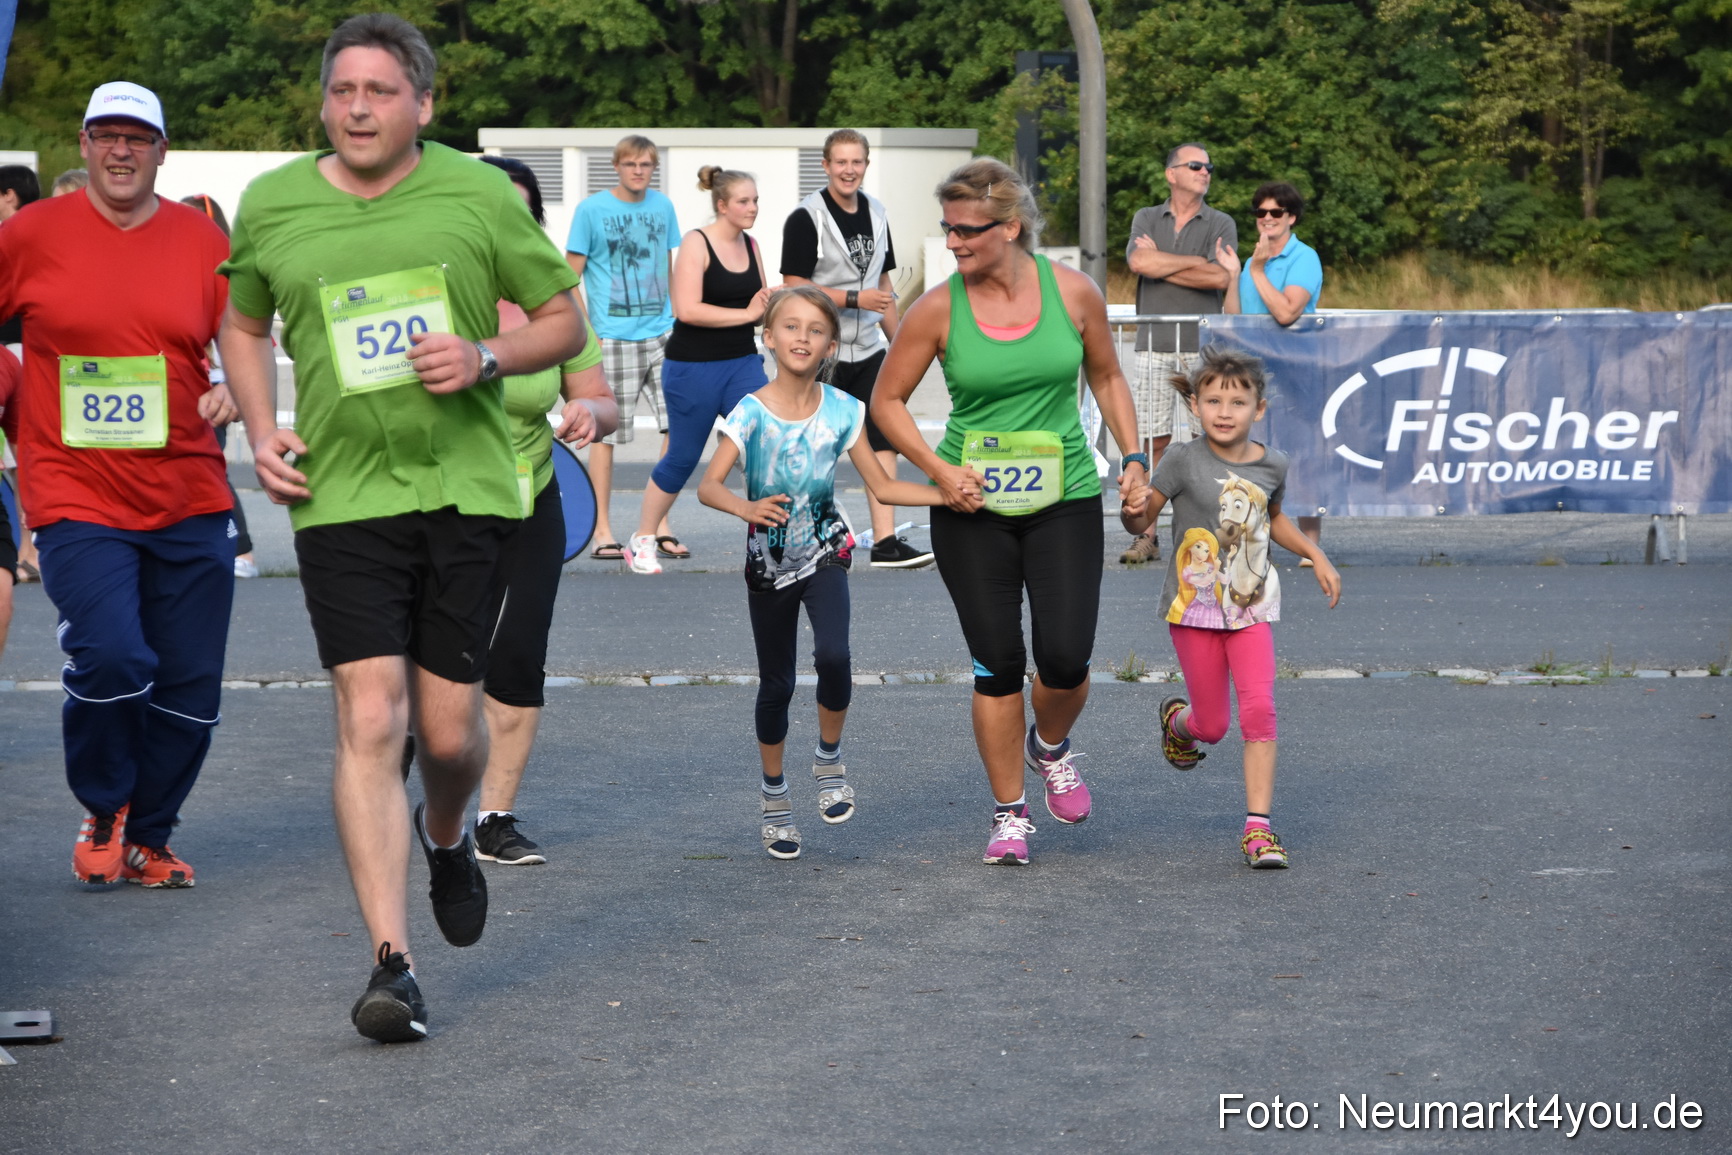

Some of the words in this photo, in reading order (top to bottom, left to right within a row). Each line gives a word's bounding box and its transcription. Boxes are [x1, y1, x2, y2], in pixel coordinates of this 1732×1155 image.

[602, 213, 633, 235] PALM
[356, 314, 429, 360] 520
[361, 363, 400, 376] Karl-Heinz
[82, 393, 145, 423] 828
[1385, 397, 1680, 452] Fischer
[983, 465, 1043, 493] 522
[1411, 460, 1654, 485] AUTOMOBILE
